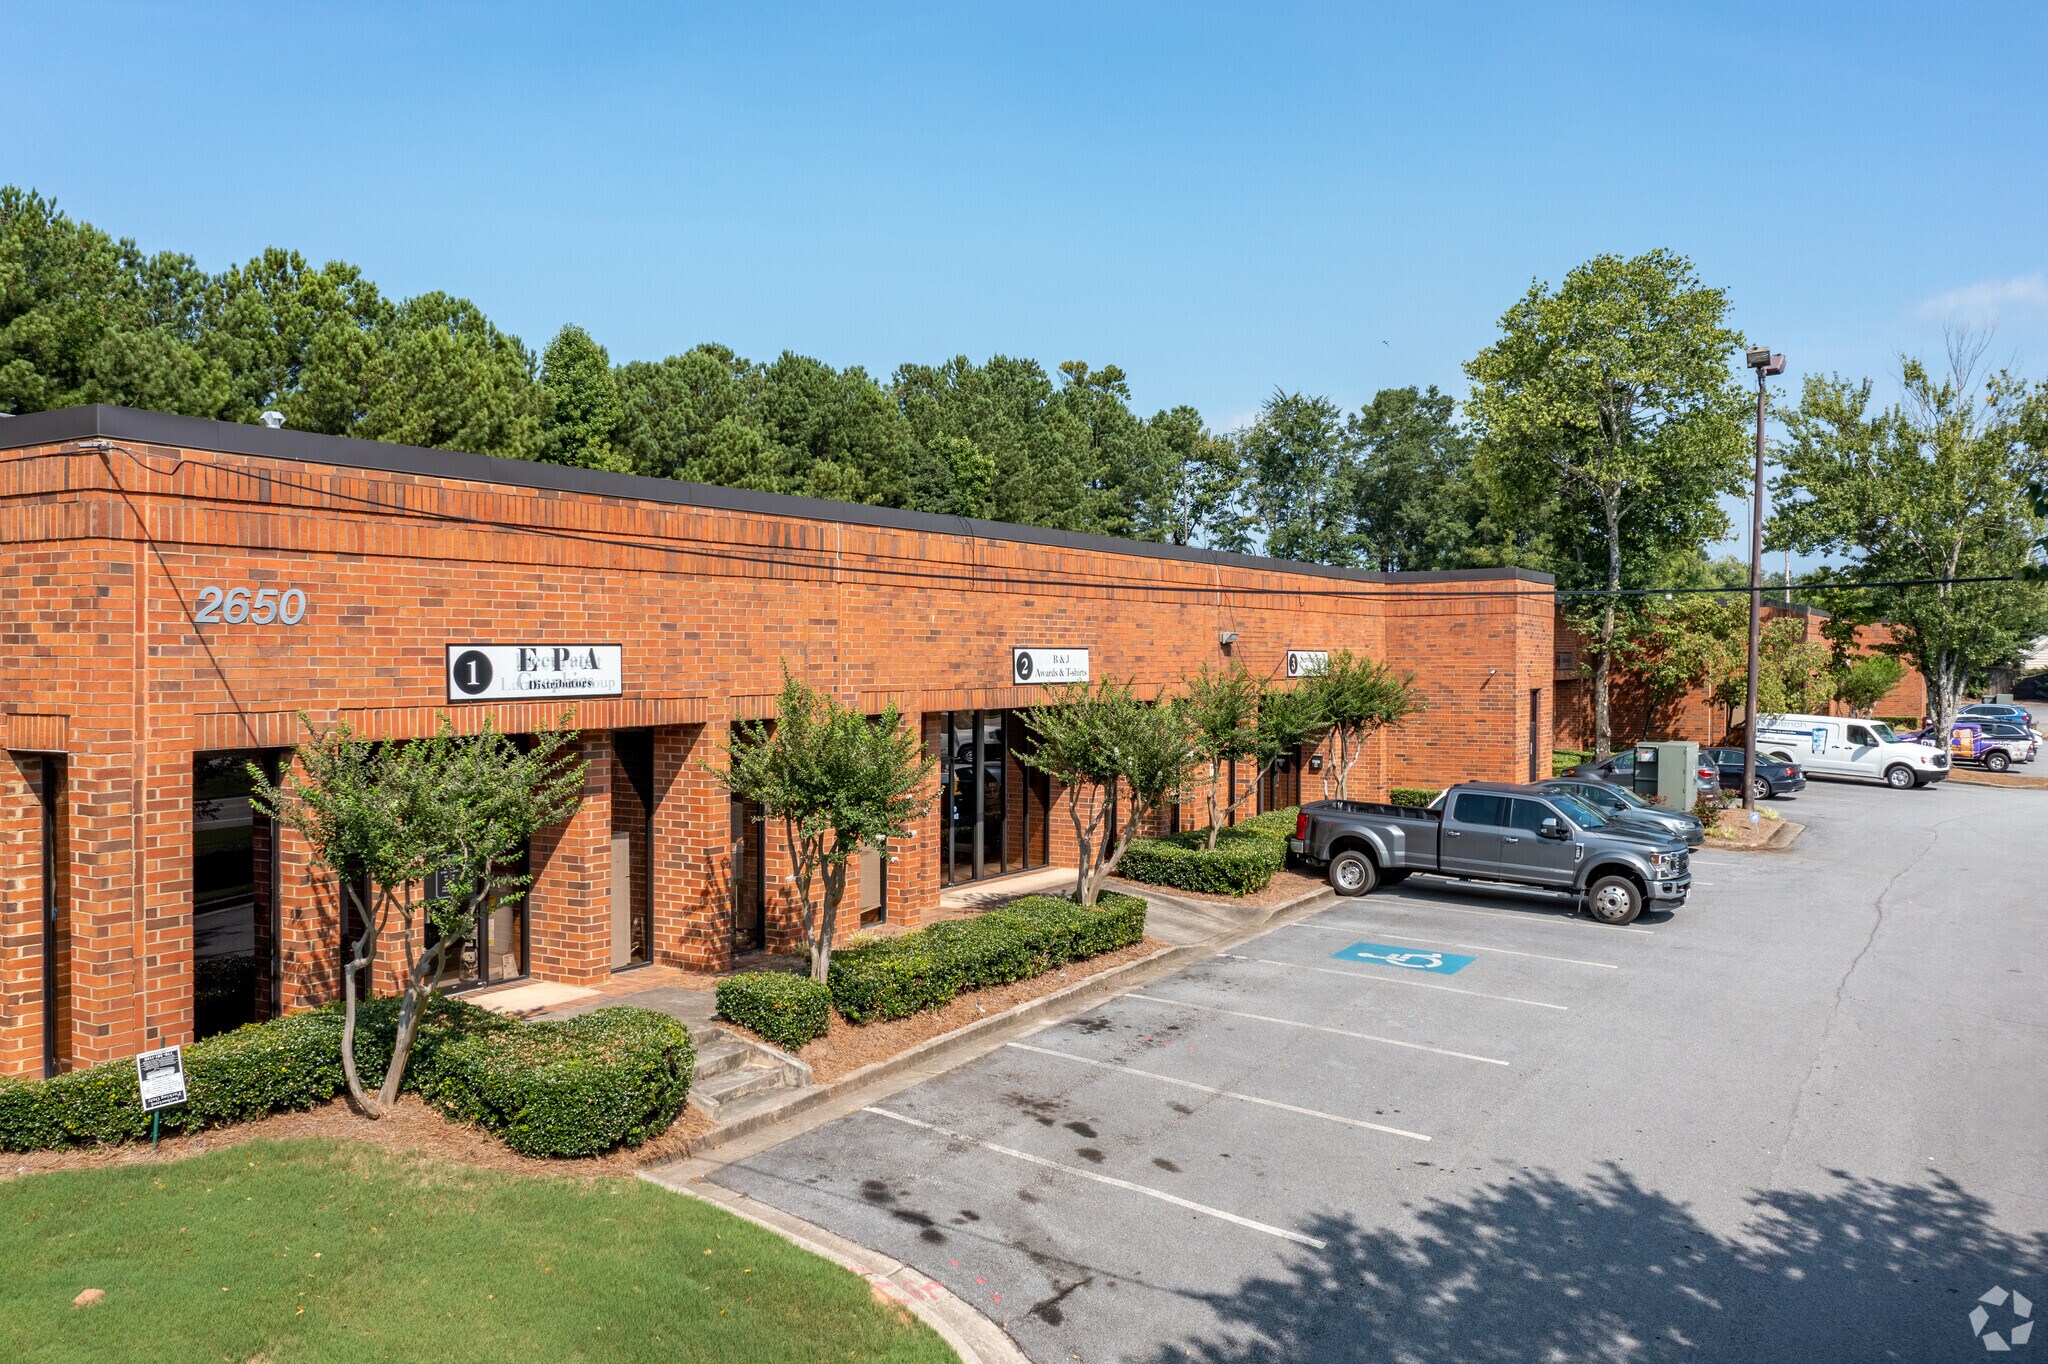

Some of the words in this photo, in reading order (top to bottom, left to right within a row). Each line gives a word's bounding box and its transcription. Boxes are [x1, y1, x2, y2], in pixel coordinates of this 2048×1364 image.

[194, 586, 306, 626] 2650
[466, 659, 480, 686] 1
[1021, 657, 1029, 675] 2
[1035, 668, 1058, 677] Awards
[529, 679, 593, 690] Distributors
